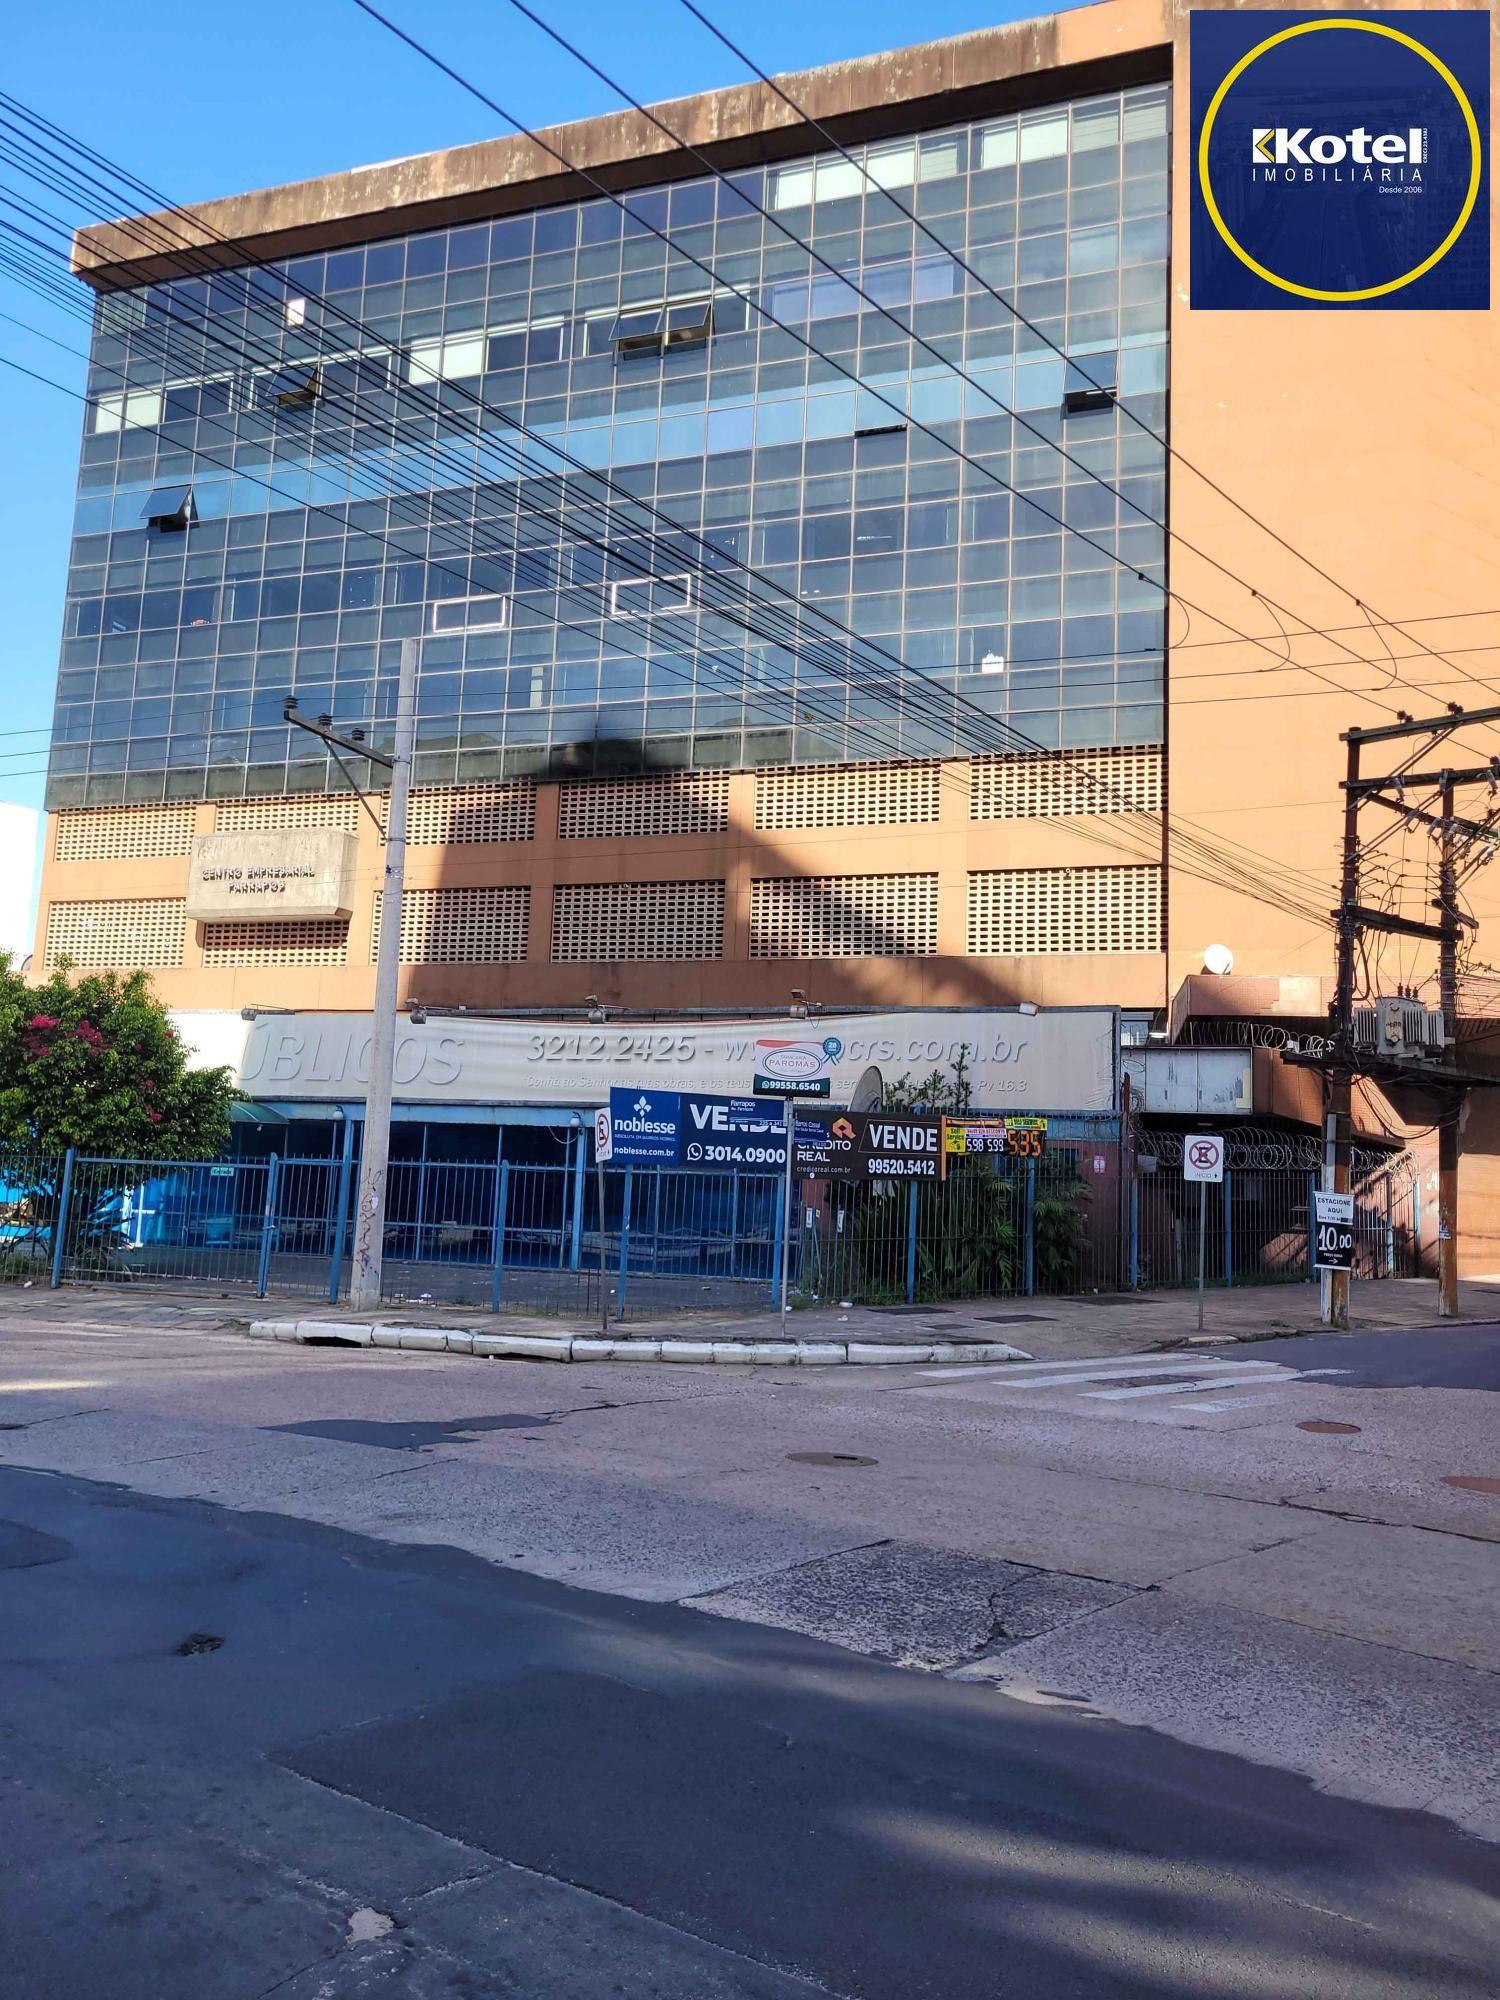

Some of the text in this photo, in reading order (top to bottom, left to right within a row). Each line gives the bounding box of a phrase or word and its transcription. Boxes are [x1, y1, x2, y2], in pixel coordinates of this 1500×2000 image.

[202, 864, 315, 881] CENTRO EMPRESARIAL
[228, 881, 286, 894] FARRAPOS
[527, 1035, 696, 1062] 3212.2425
[769, 1059, 816, 1068] PAROMAS
[770, 1081, 820, 1091] 99558.6540
[731, 1100, 756, 1108] Farrapos
[614, 1117, 676, 1134] noblesse
[869, 1124, 938, 1151] VENDE
[614, 1146, 675, 1157] noblesse.com.br
[704, 1146, 786, 1163] 3014.0900
[797, 1151, 831, 1162] REAL
[868, 1158, 935, 1175] 99520.5412
[1317, 1197, 1351, 1207] ESTACIONE
[1318, 1224, 1352, 1251] 10,00
